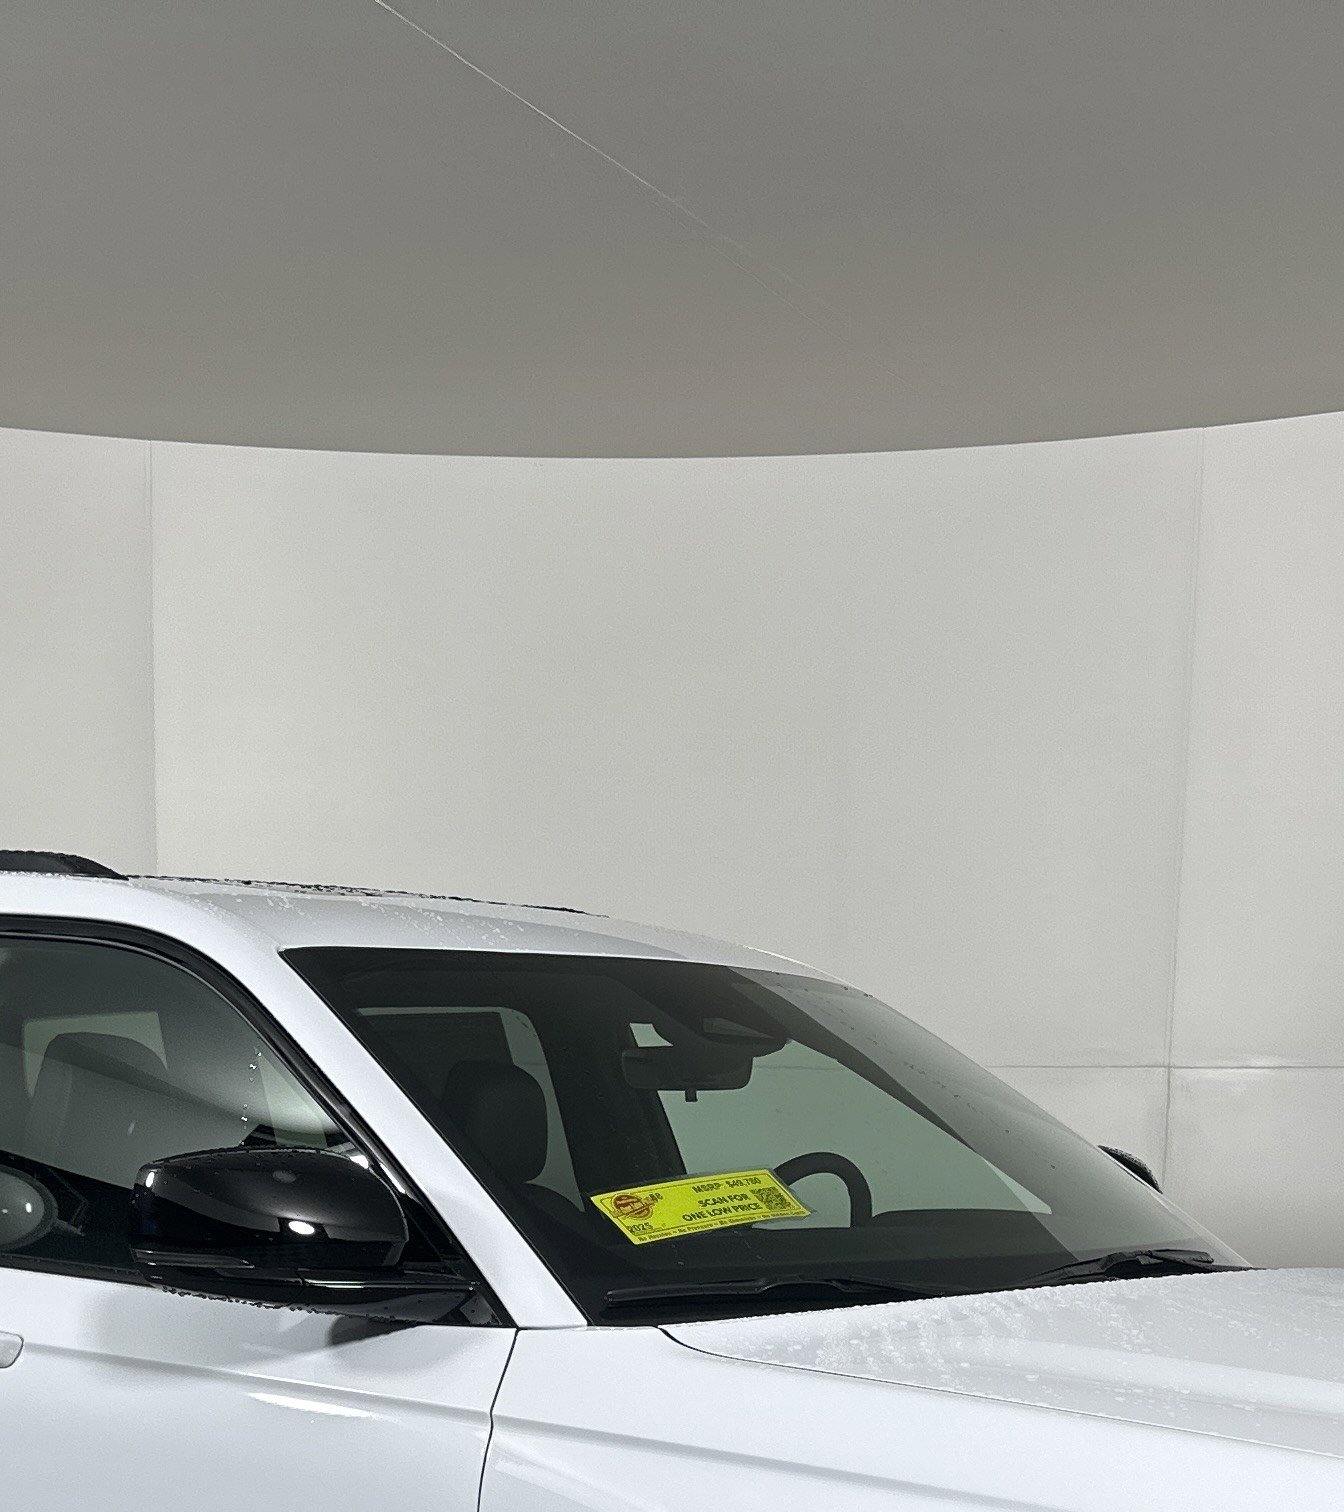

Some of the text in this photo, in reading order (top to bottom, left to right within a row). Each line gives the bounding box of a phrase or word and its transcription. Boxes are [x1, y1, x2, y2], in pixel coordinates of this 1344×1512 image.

[697, 1193, 750, 1207] SCAN FOR
[682, 1210, 708, 1221] ONE
[706, 1206, 732, 1217] LOW
[731, 1202, 763, 1213] PRICE
